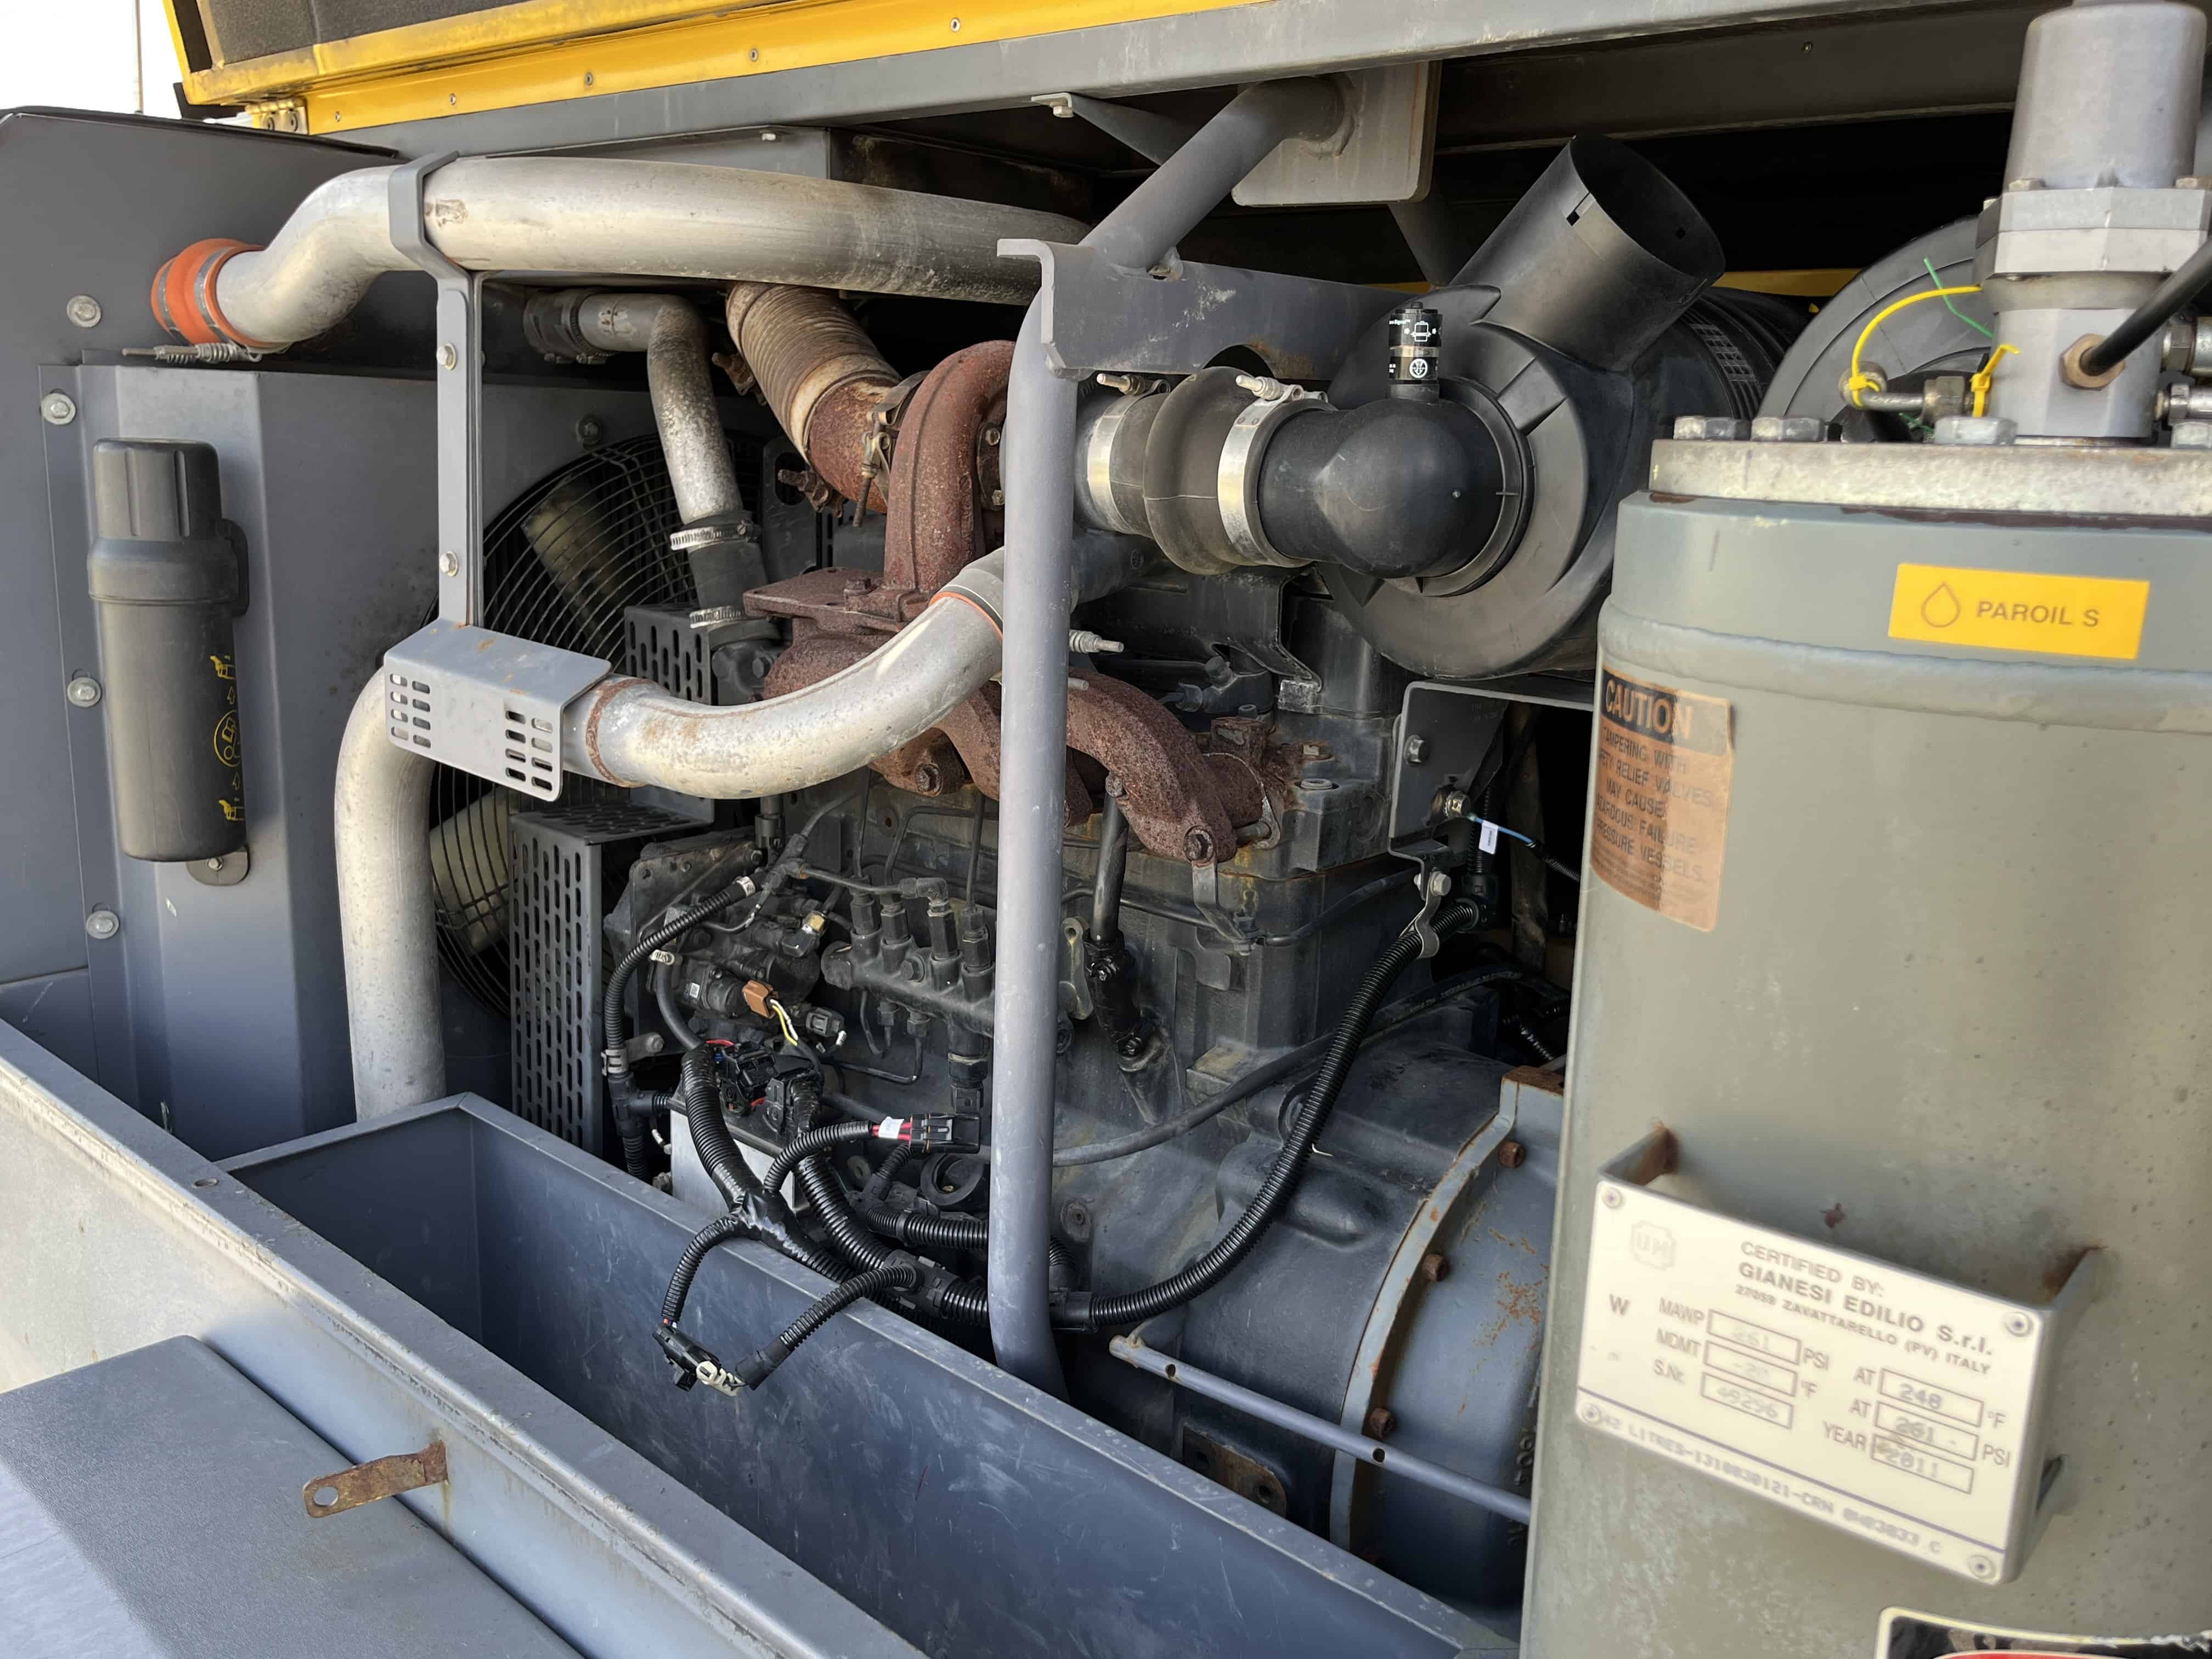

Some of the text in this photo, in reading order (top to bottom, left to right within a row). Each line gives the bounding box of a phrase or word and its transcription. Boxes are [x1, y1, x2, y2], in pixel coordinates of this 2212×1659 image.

[1976, 600, 2101, 628] PAROIL S
[1605, 679, 1694, 739] CAUTION
[1616, 759, 1649, 786] RELIEF
[1655, 775, 1713, 807] VALVES
[1654, 750, 1686, 774] WITH
[1606, 777, 1666, 816] MAY CAUSE
[1639, 820, 1696, 853] FAILURE
[1641, 844, 1703, 879] VESSELS
[1740, 1240, 1884, 1297] CERTIFIED BY:
[1609, 1293, 1630, 1316] W
[1738, 1262, 1992, 1356] GIANESI EDILIO S.r.l.
[1658, 1297, 1705, 1325] MAWP
[1803, 1347, 1830, 1371] PSI
[1853, 1367, 1876, 1386] AT
[1899, 1383, 1942, 1410] 248
[1782, 1299, 1898, 1345] ZAVATTARELLO
[1904, 1339, 1939, 1361] (PV)
[1945, 1352, 1991, 1374] ITALY
[1656, 1328, 1702, 1358] MDMT
[1849, 1398, 1872, 1418] AT
[1982, 1443, 2011, 1468] PSI
[1822, 1420, 1869, 1453] YEAR
[1886, 1447, 1938, 1479] 2011
